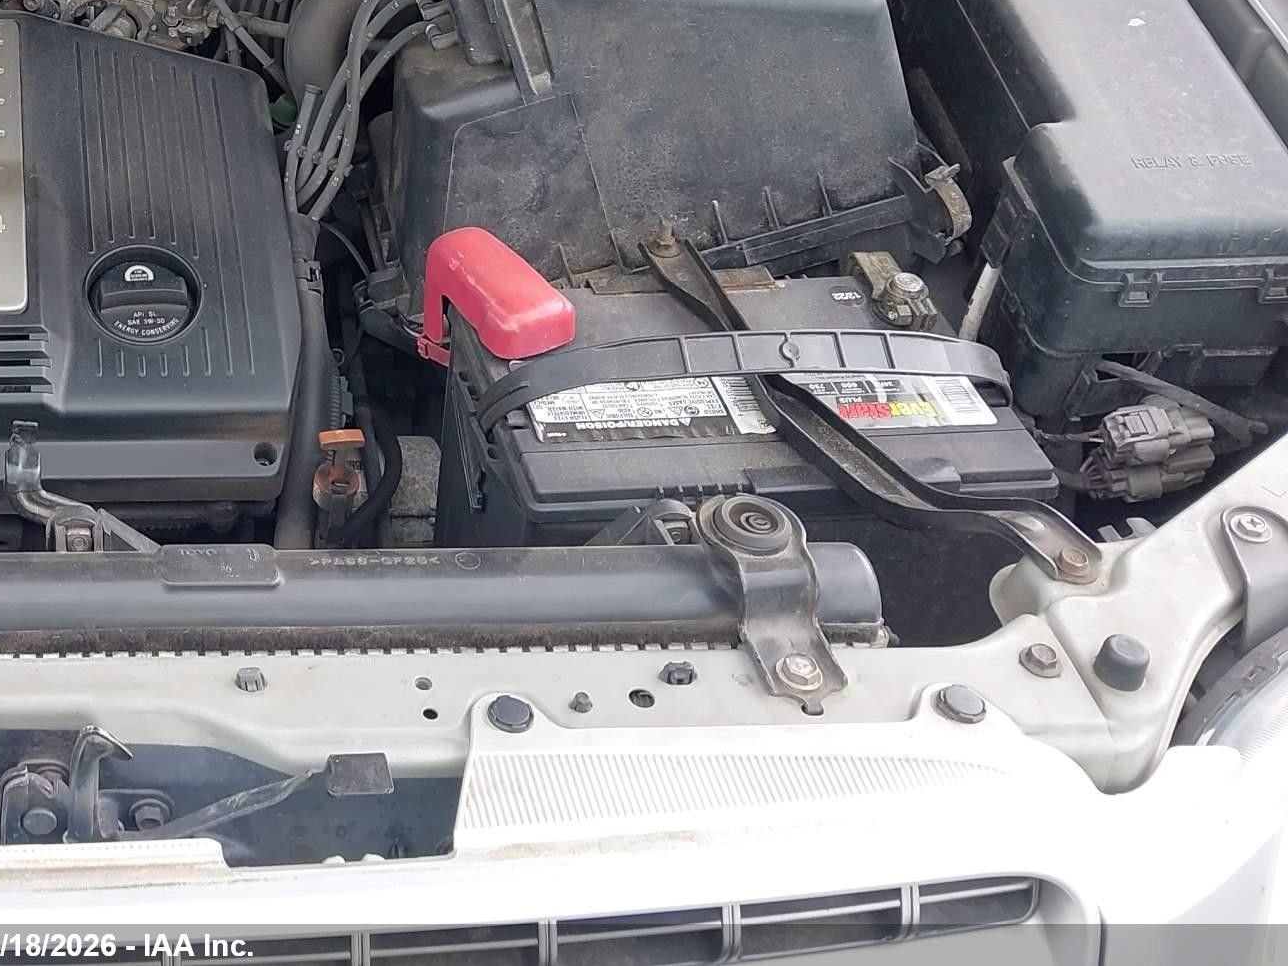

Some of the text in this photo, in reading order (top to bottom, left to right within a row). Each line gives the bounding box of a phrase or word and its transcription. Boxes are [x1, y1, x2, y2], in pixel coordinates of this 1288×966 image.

[1130, 156, 1182, 169] RELAY
[1207, 153, 1254, 167] FUSE
[114, 317, 179, 336] ENERGY CONSERVING
[837, 401, 938, 420] EverStart
[575, 418, 680, 430] DANGER/POISON
